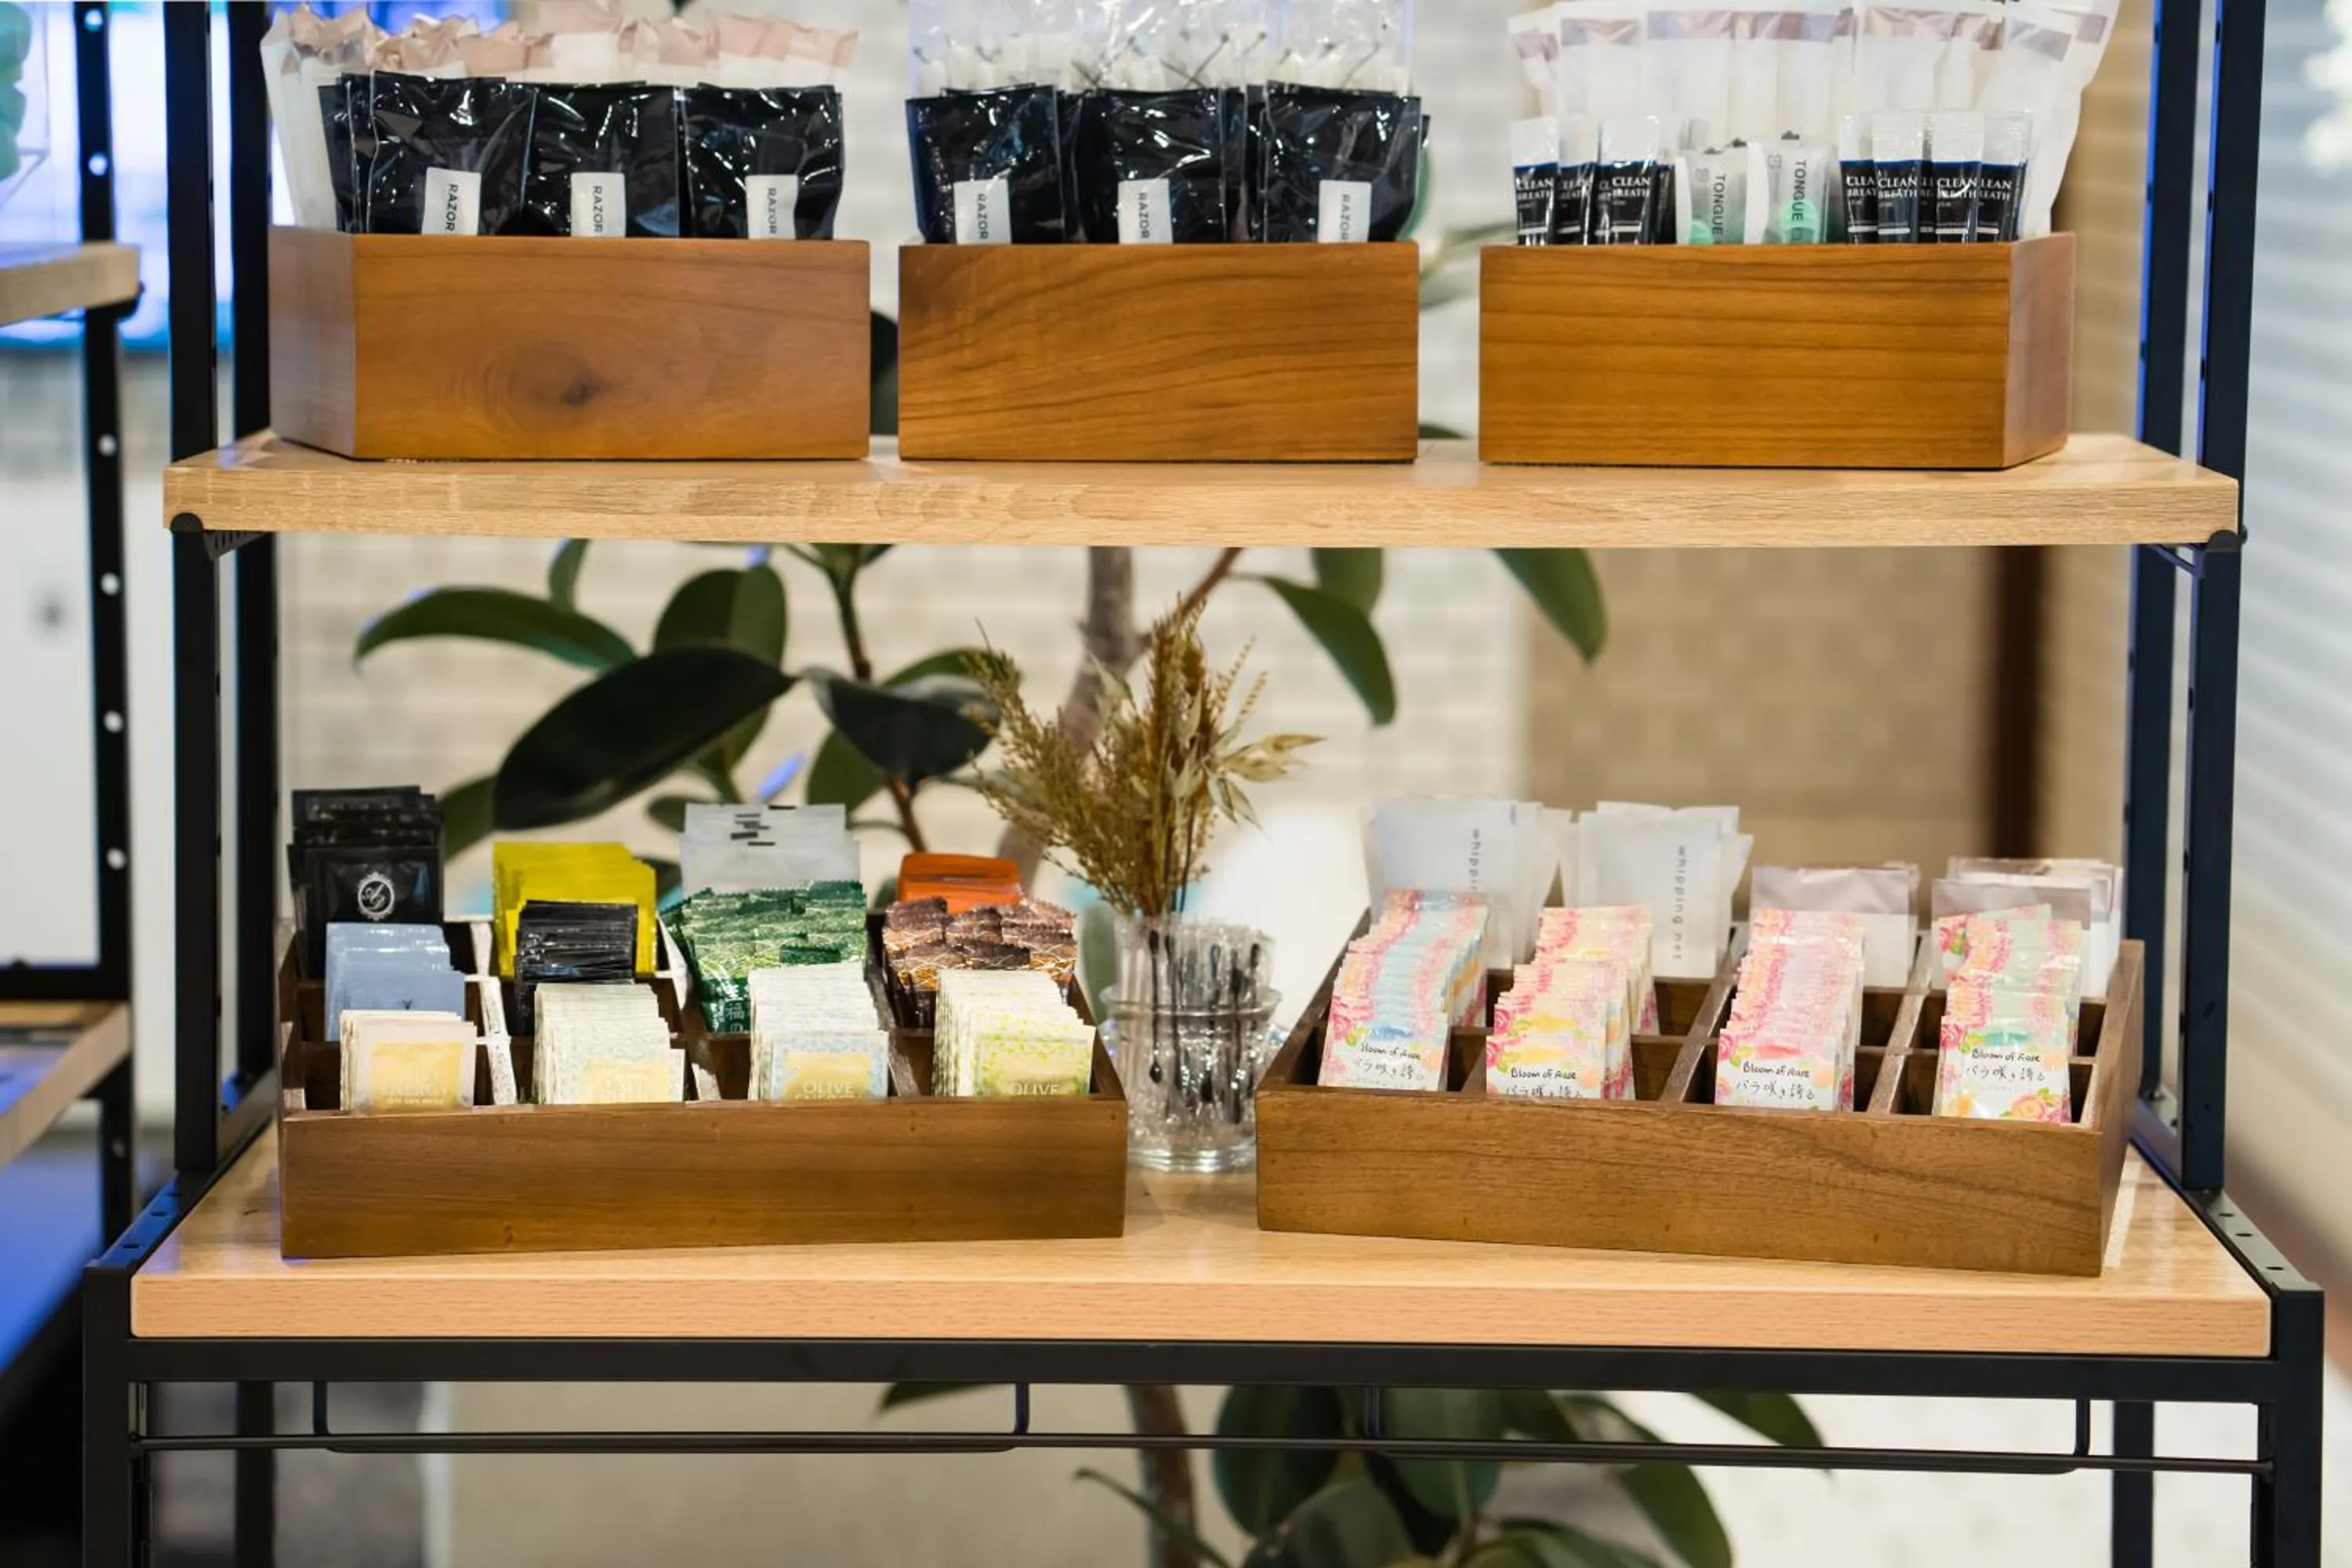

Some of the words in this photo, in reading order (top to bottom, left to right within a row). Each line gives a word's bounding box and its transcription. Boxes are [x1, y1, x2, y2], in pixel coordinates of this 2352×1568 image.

[1516, 177, 1554, 190] CLEAN
[1612, 176, 1651, 187] CLEAN
[1846, 176, 1876, 187] CLEA
[1878, 175, 1918, 188] CLEAN
[1937, 176, 1978, 188] CLEAN
[1980, 178, 2013, 190] LEAN
[1613, 187, 1650, 198] BREATH
[1791, 159, 1806, 222] TONGUE
[1847, 188, 1877, 198] BREAT
[1878, 188, 1918, 199] BREATH
[445, 183, 459, 232] RAZOR
[593, 186, 603, 233] RAZOR
[768, 187, 777, 234] RAZOR
[1712, 174, 1726, 236] TONGUE
[978, 194, 989, 239] RAZOR
[1138, 192, 1150, 239] RAZOR
[1340, 194, 1350, 240] RAZOR
[1672, 845, 1687, 924] whipping
[1672, 932, 1682, 960] net
[1972, 1047, 2003, 1058] Bloom
[2005, 1051, 2015, 1062] of
[1511, 1068, 1541, 1078] Bloom
[1542, 1069, 1553, 1079] of
[1743, 1061, 1774, 1073] Bloom
[1776, 1065, 1788, 1074] of
[802, 1080, 854, 1094] OLIVE
[1008, 1081, 1060, 1095] OLIVE
